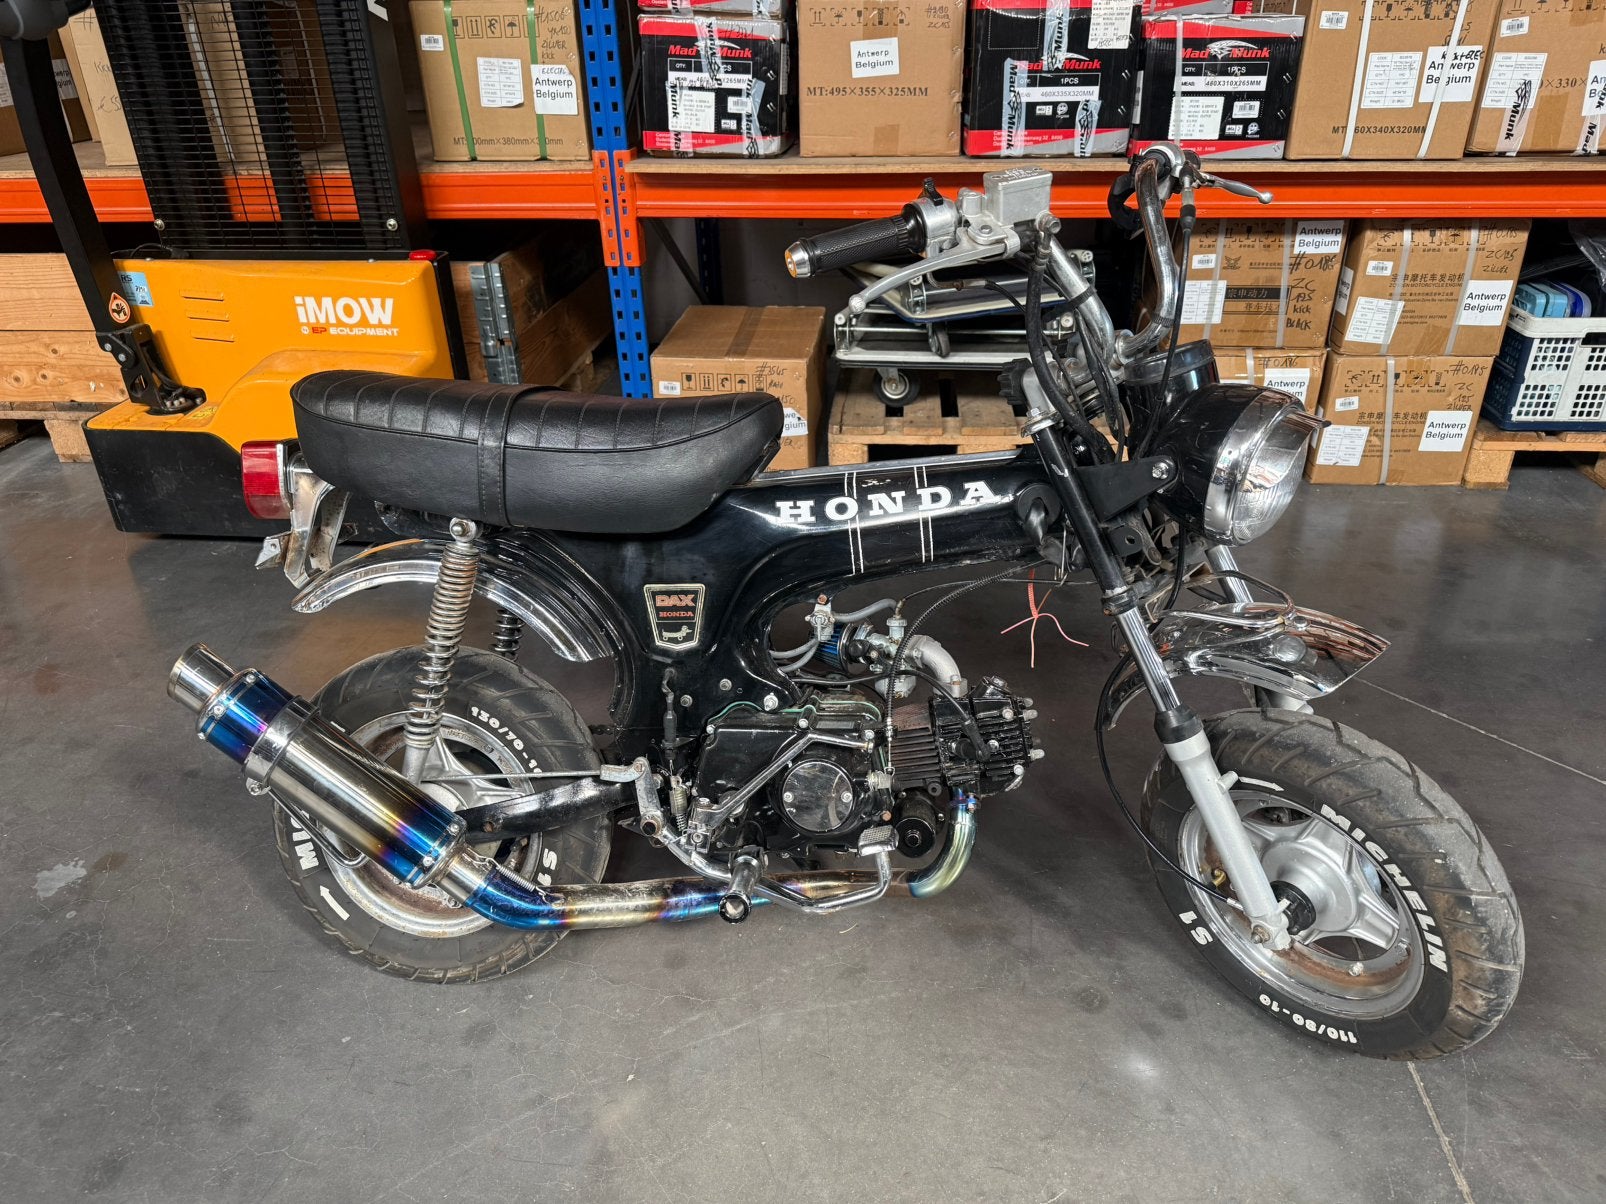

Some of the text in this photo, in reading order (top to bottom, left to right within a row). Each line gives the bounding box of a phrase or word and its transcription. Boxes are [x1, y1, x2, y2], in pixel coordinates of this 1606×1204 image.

[668, 45, 698, 56] Mad
[857, 50, 889, 59] Antwerp
[1181, 47, 1271, 58] Mad Munk
[855, 59, 894, 69] Belgium
[1063, 59, 1102, 70] Munk
[1427, 61, 1476, 72] Anwerp
[534, 77, 573, 88] Antwerp
[1425, 74, 1472, 86] Begium
[536, 90, 573, 101] Belgium
[1504, 101, 1522, 141] Munk
[1005, 113, 1016, 150] Munk
[1300, 226, 1342, 237] Antwerp
[1298, 239, 1340, 249] Belgium
[1466, 292, 1507, 302] Antwerp
[294, 295, 394, 325] iMOW
[1463, 303, 1503, 314] Belgium
[329, 327, 399, 336] EQUIPMENT
[1266, 380, 1306, 389] Antwerp
[1427, 421, 1467, 431] Antwerp
[1425, 431, 1463, 441] Belgium
[775, 480, 995, 523] HONDA
[655, 594, 696, 607] DAX
[1320, 803, 1449, 973] MICHELIN
[1259, 993, 1358, 1044] 110/80-10
